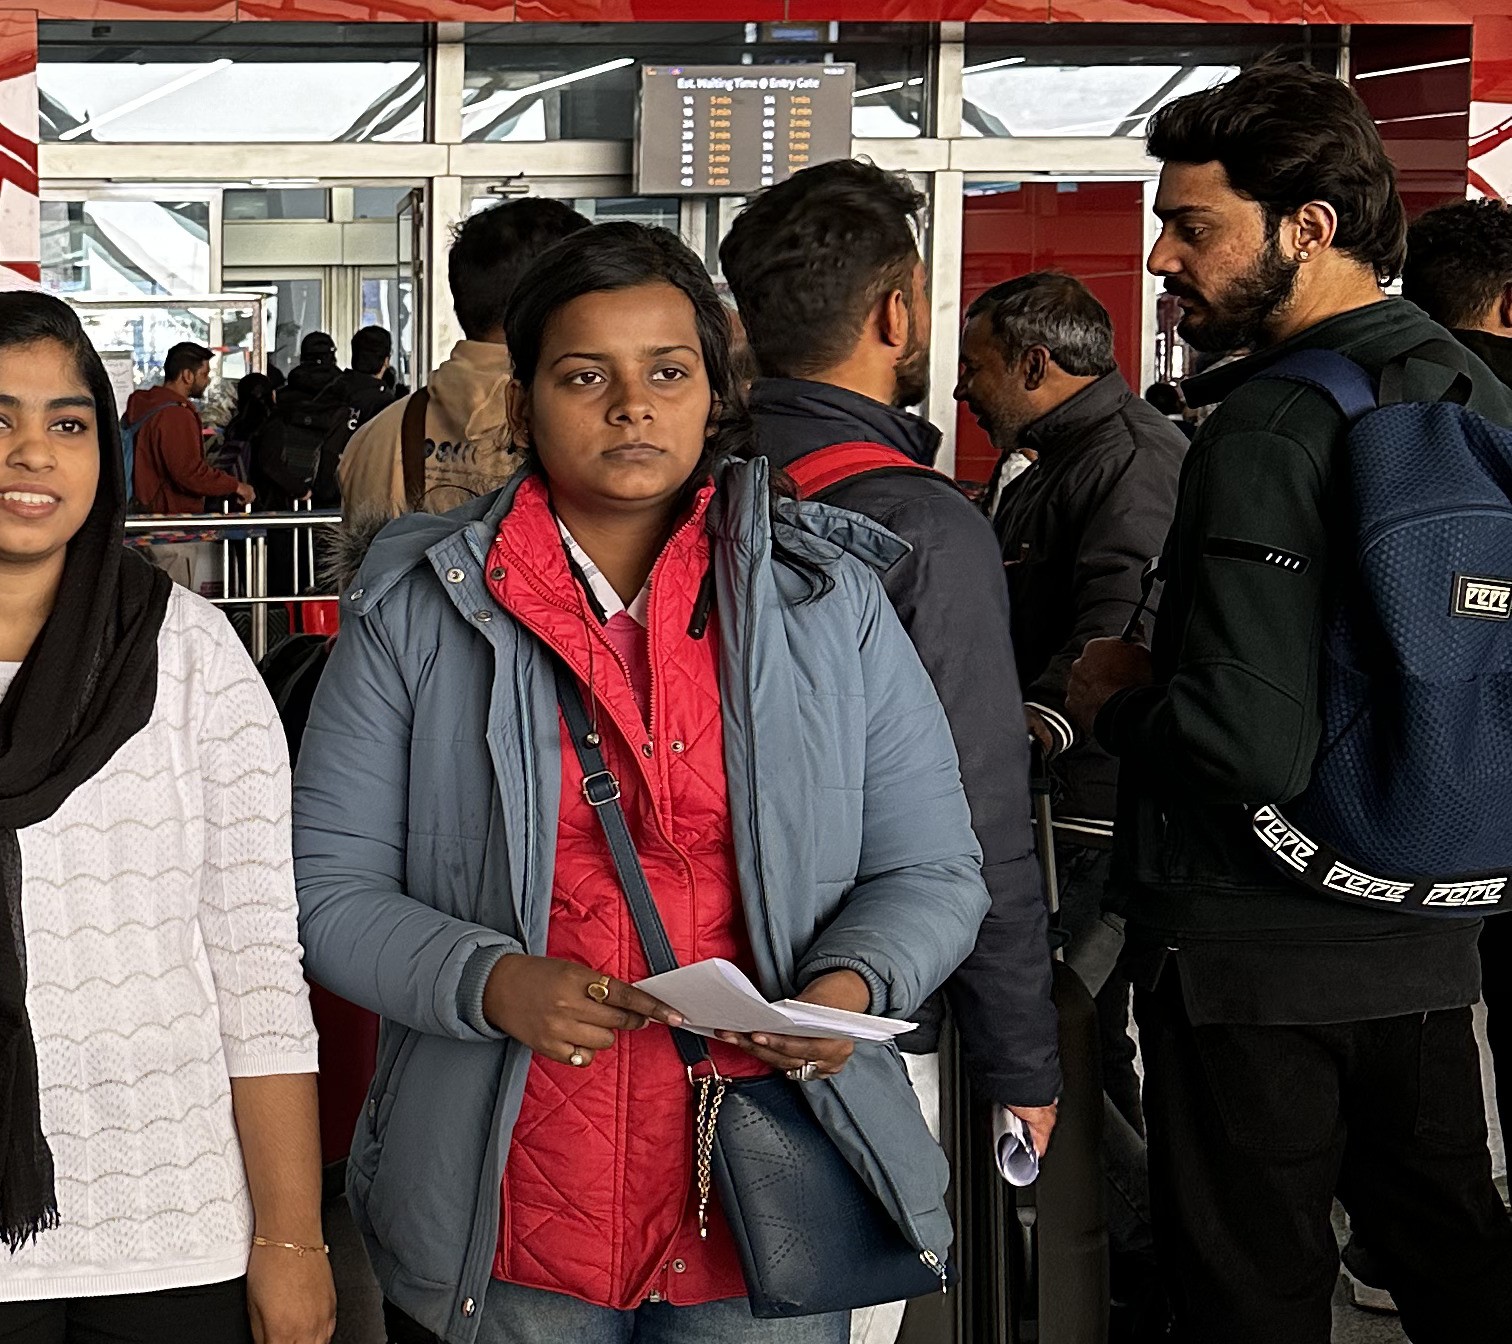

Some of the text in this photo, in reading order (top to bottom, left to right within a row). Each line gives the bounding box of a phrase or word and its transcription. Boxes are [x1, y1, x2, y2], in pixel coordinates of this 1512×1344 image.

[677, 77, 820, 92] Est. Waiting Time @ Entry Gate
[717, 96, 733, 105] min
[795, 96, 811, 105] min
[717, 108, 732, 117] min
[797, 108, 813, 117] min
[710, 120, 715, 129] 1
[715, 120, 731, 129] min
[796, 119, 812, 129] min
[716, 131, 731, 141] min
[795, 131, 811, 140] min
[715, 143, 731, 152] min
[794, 142, 809, 151] min
[715, 155, 731, 164] min
[793, 154, 809, 163] min
[708, 166, 714, 175] 1
[714, 166, 729, 175] min
[715, 178, 731, 187] min
